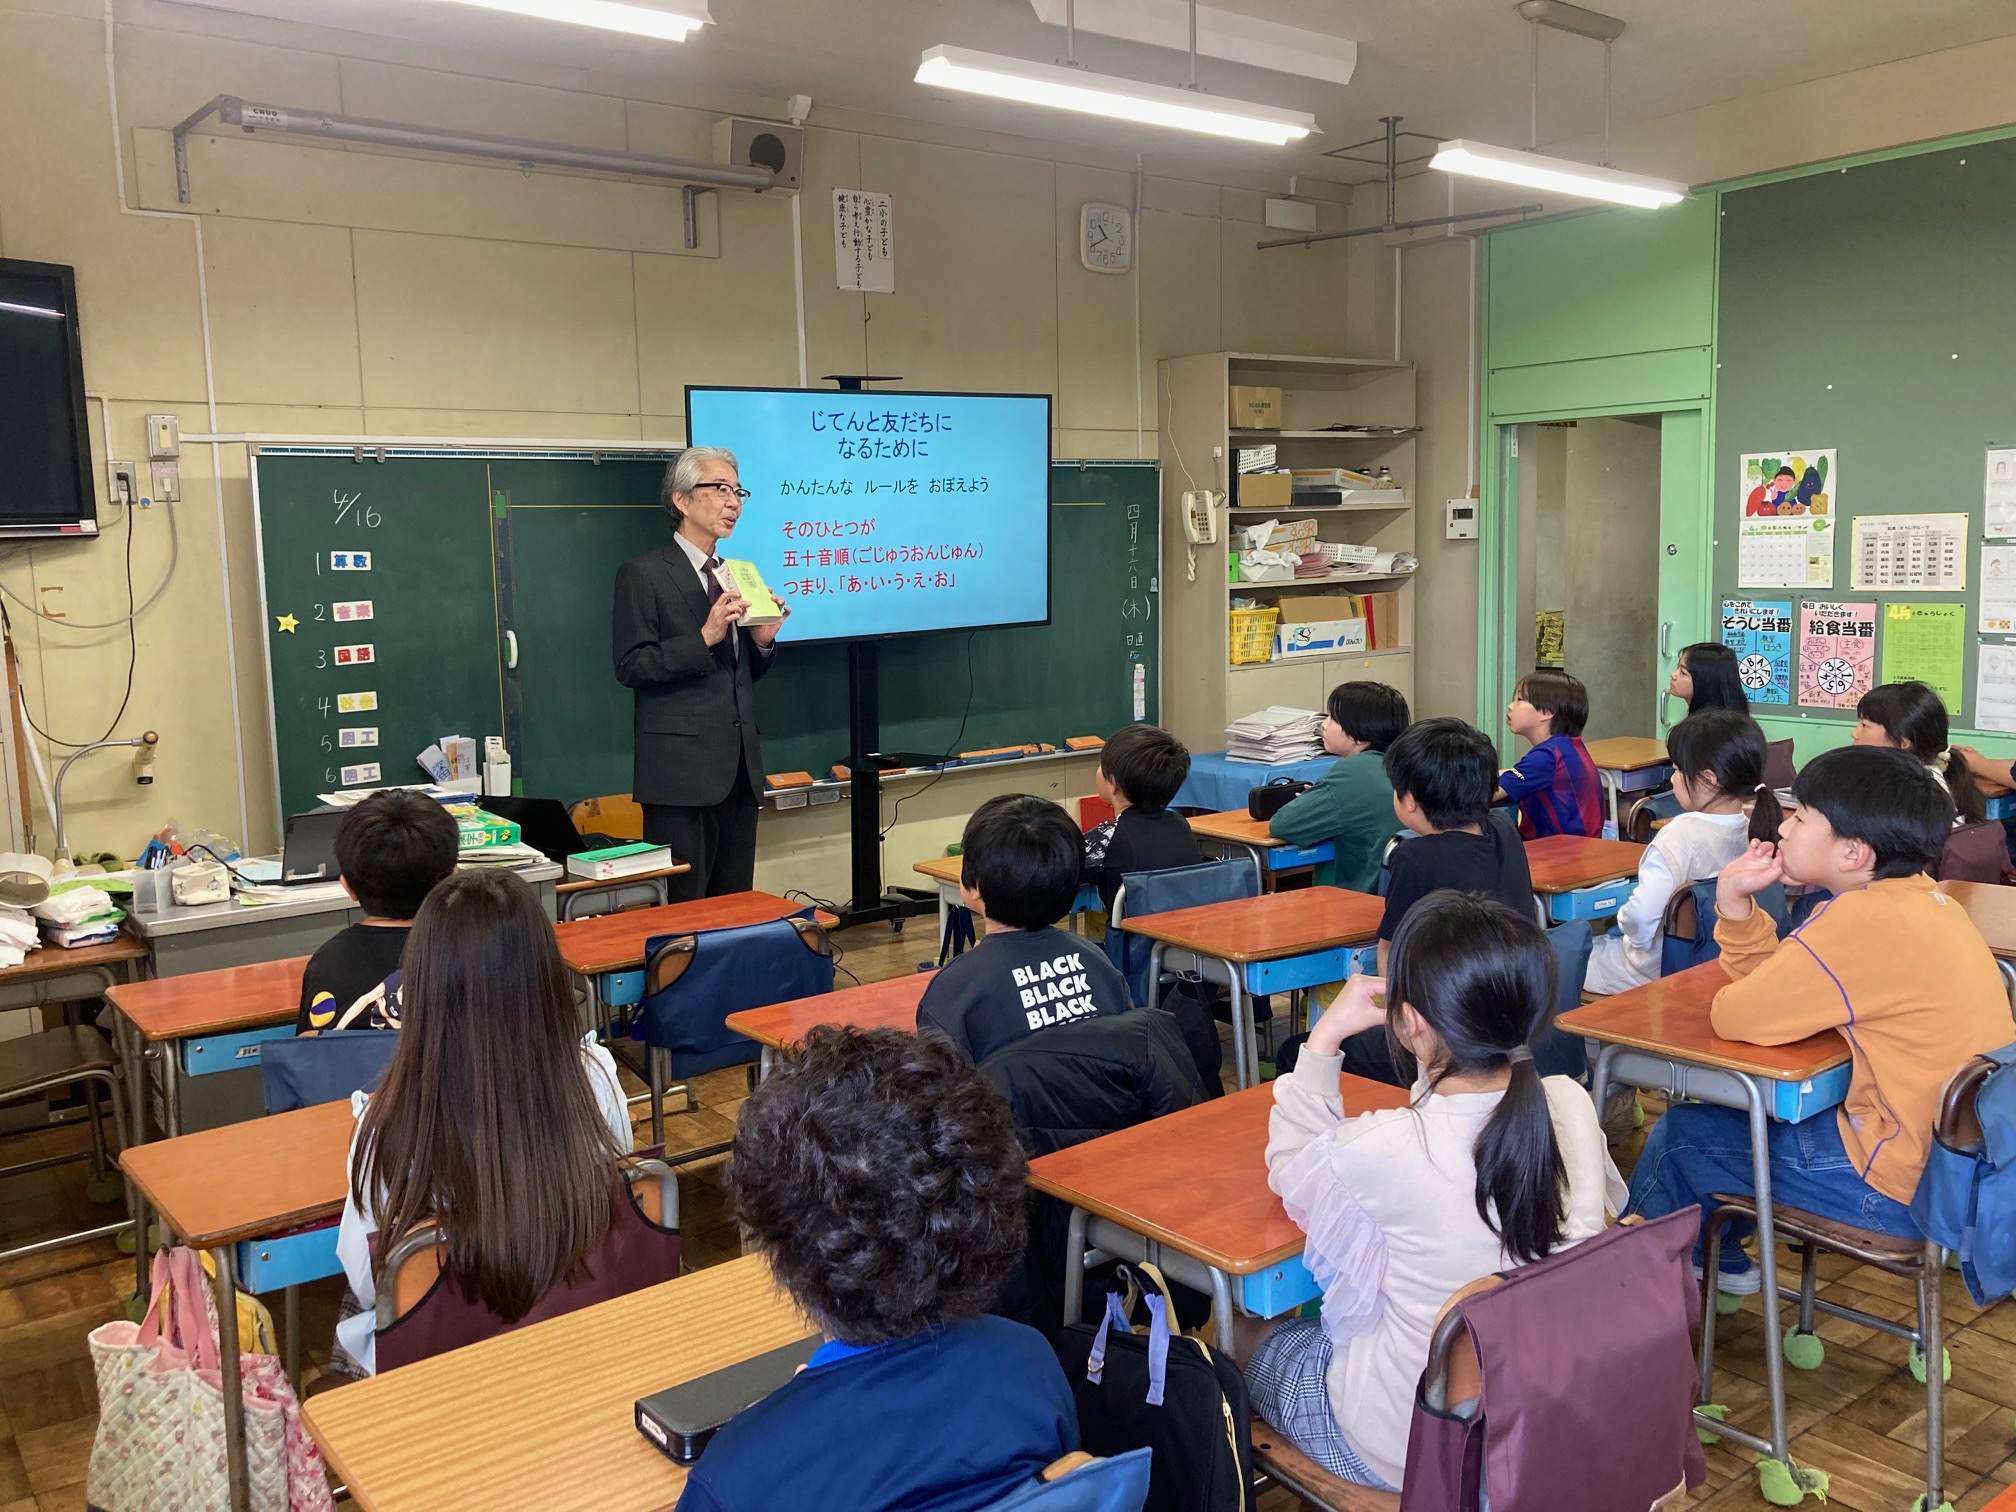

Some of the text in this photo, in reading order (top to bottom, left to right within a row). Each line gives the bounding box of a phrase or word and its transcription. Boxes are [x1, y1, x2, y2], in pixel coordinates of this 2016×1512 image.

[878, 201, 888, 257] 二小の子ども
[811, 410, 953, 433] じてんと友だちに
[838, 437, 928, 459] なるために
[780, 476, 990, 496] かんたんな ルールを おぼえよう
[333, 489, 382, 528] 4/16
[782, 518, 876, 539] そのひとつが
[782, 543, 985, 568] 五十音順（ごじゅうおんじゅん）
[314, 603, 326, 621] 2
[1723, 616, 1792, 632] そうじ当番
[1809, 620, 1874, 637] 給食当番
[315, 650, 326, 669] 3
[338, 647, 370, 663] 国語
[318, 696, 331, 719] 4
[321, 735, 332, 753] 5
[325, 768, 336, 783] 6
[1011, 953, 1085, 987] BLACK
[1019, 973, 1092, 1009] BLACK
[1025, 994, 1098, 1031] BLACK
